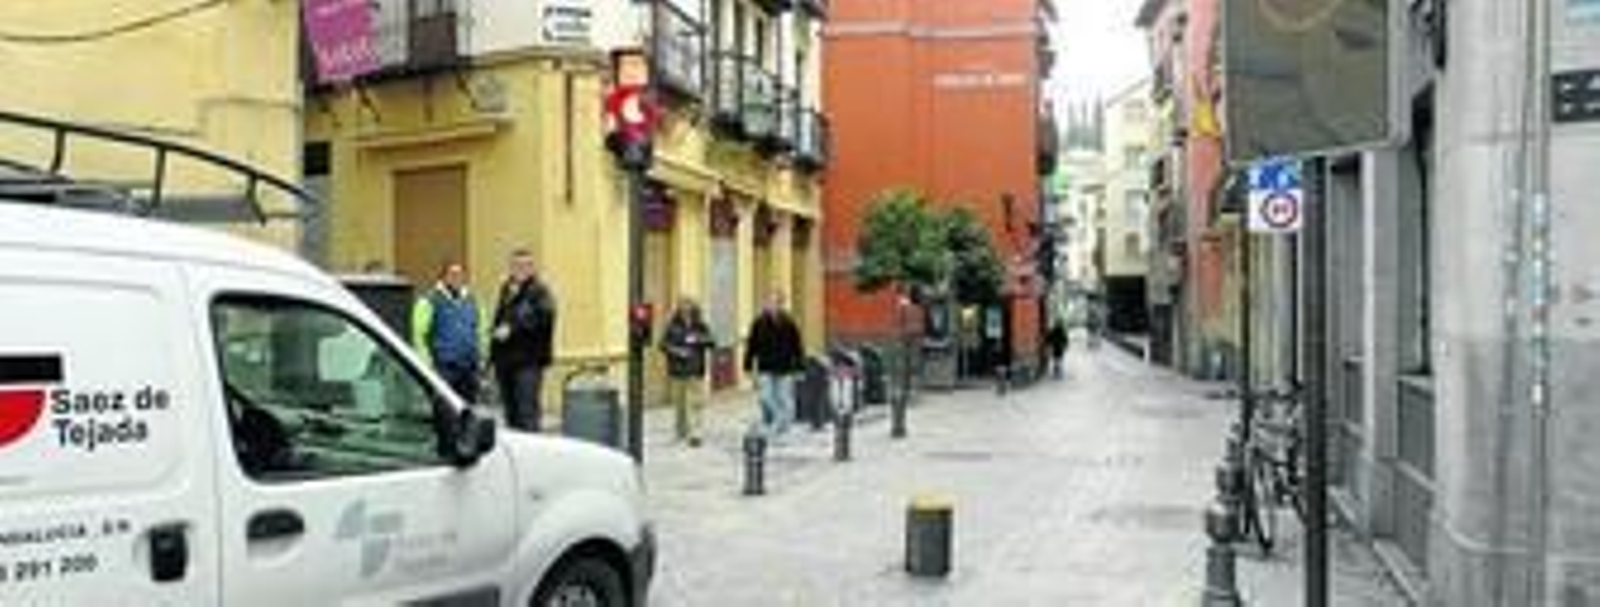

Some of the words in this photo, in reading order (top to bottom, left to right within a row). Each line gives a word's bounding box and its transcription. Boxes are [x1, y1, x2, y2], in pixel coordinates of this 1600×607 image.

[50, 388, 126, 414] Saez
[134, 385, 171, 410] de
[52, 415, 149, 452] Tejada
